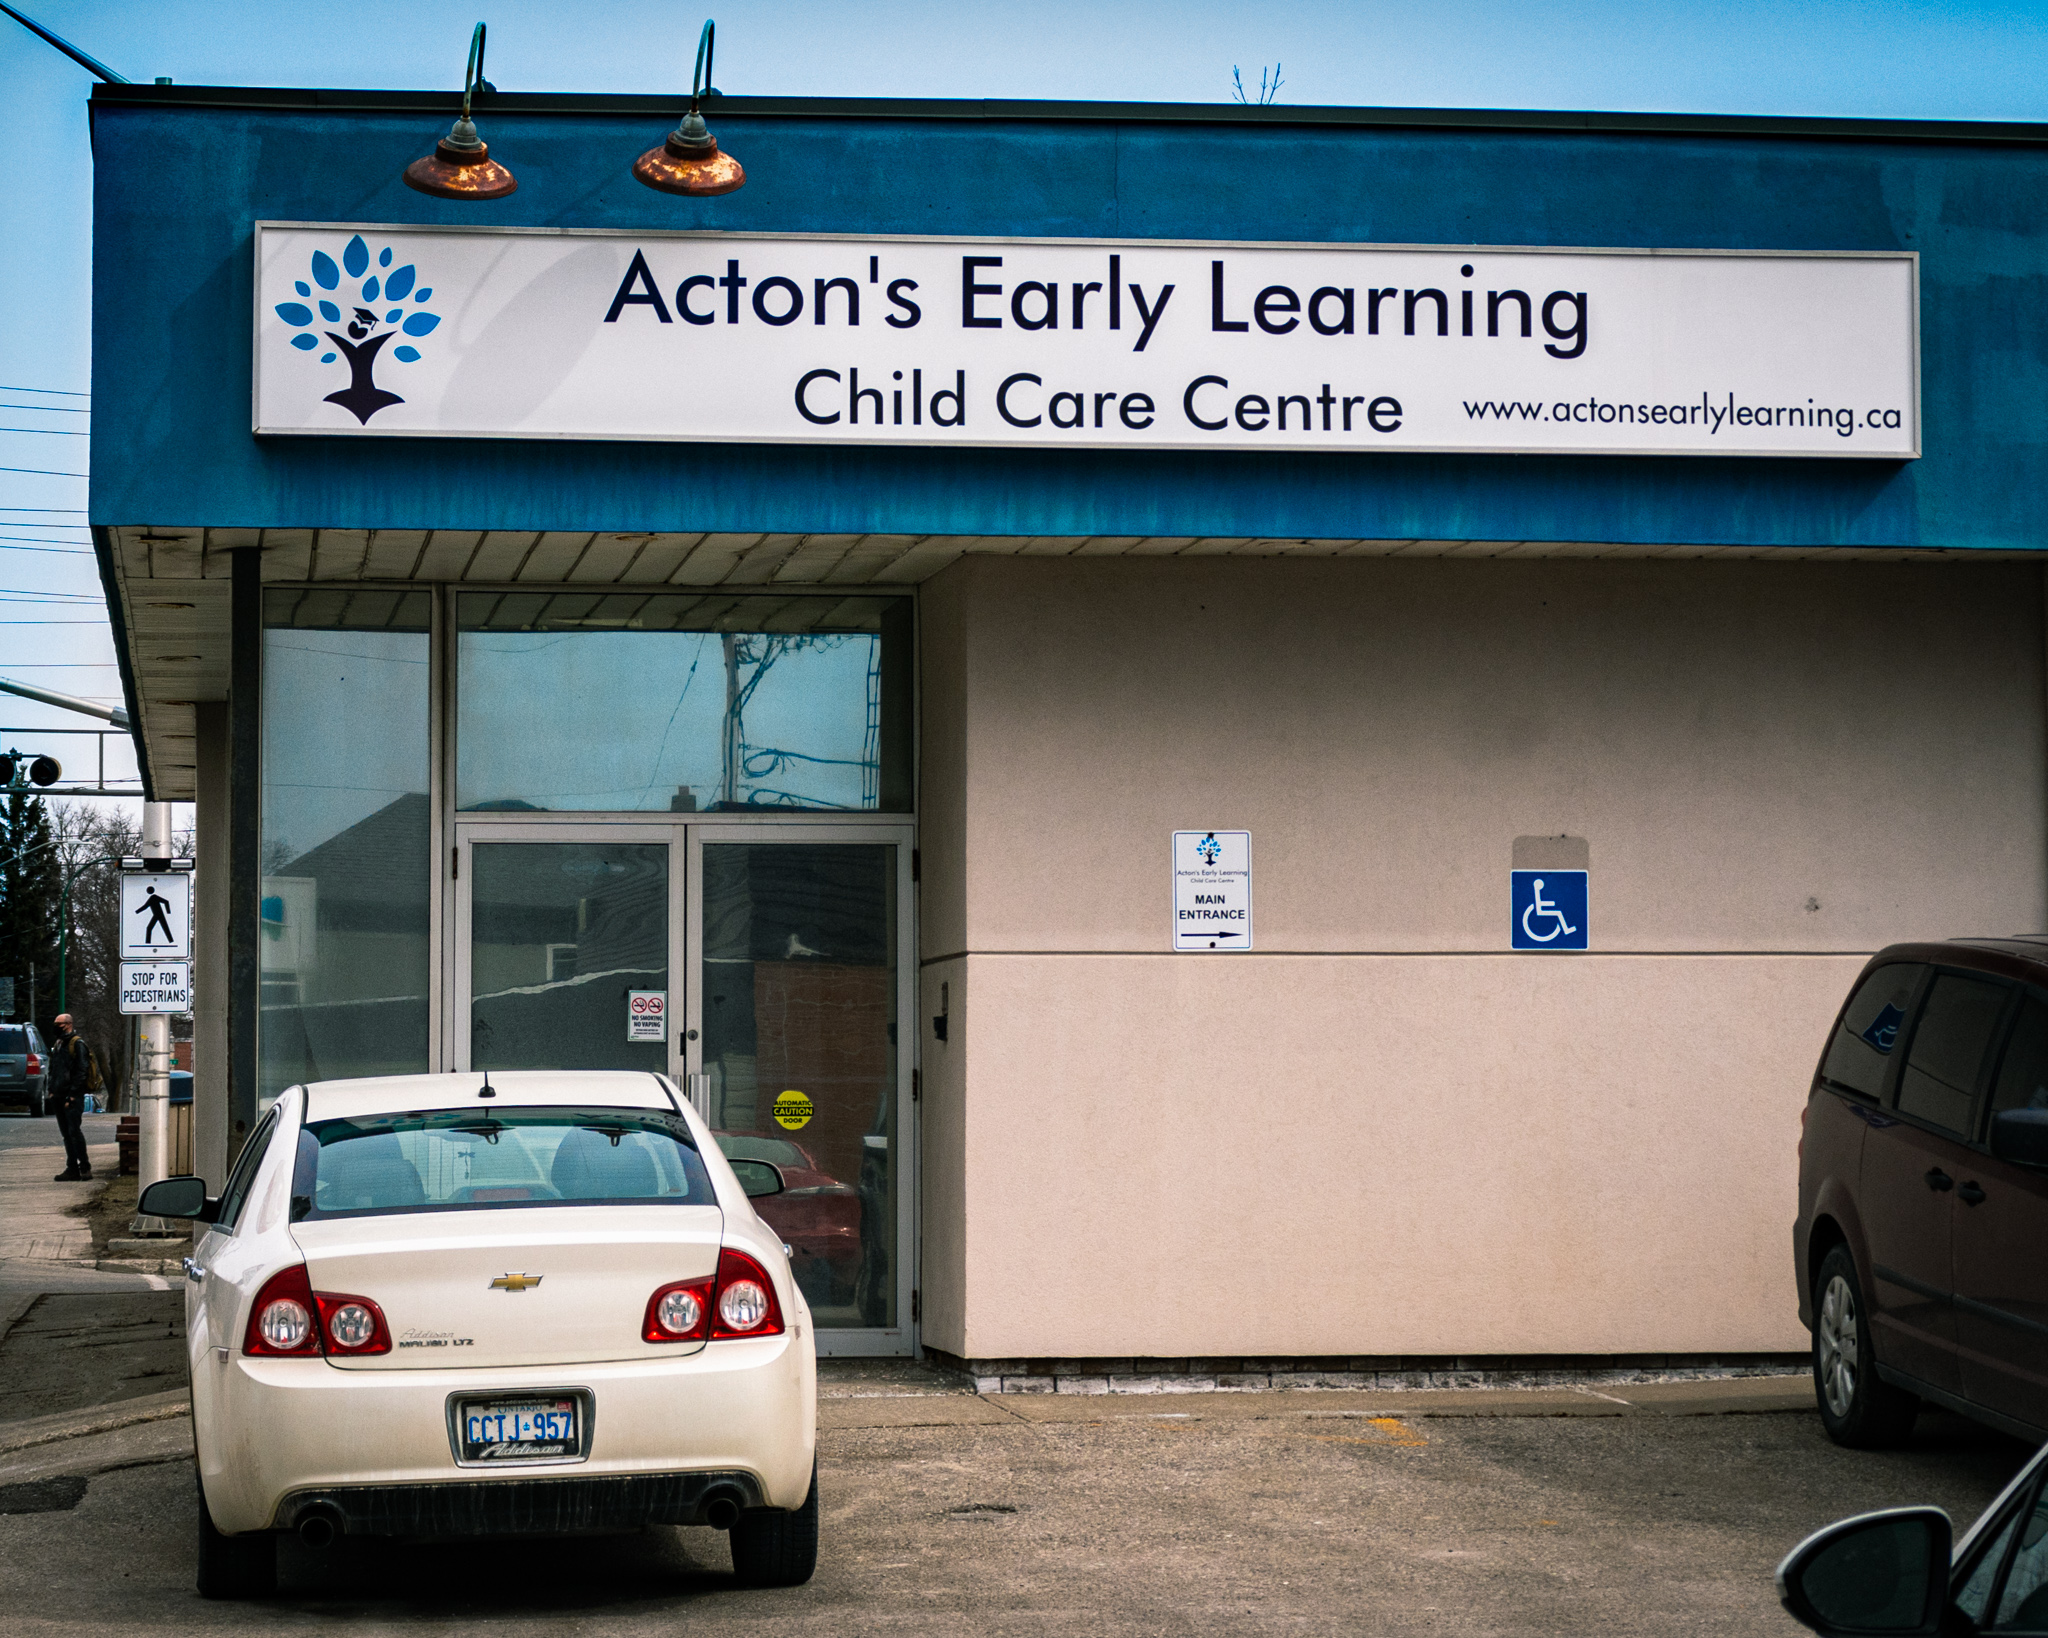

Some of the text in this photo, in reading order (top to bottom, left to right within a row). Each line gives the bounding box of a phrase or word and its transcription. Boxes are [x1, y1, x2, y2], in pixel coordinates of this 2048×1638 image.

[603, 247, 1588, 360] Acton's Early Learning
[794, 367, 1403, 433] Child Care Centre
[1463, 391, 1902, 438] www.actonsearlylearning.ca
[1219, 869, 1248, 877] Learning
[1195, 894, 1226, 905] MAIN
[1179, 910, 1245, 919] ENTRANCE
[131, 972, 178, 986] STOP FOR
[123, 989, 186, 1003] PEDESTRIANS
[399, 1338, 474, 1348] MALIBU LTZ
[468, 1412, 572, 1443] CCTJ 957
